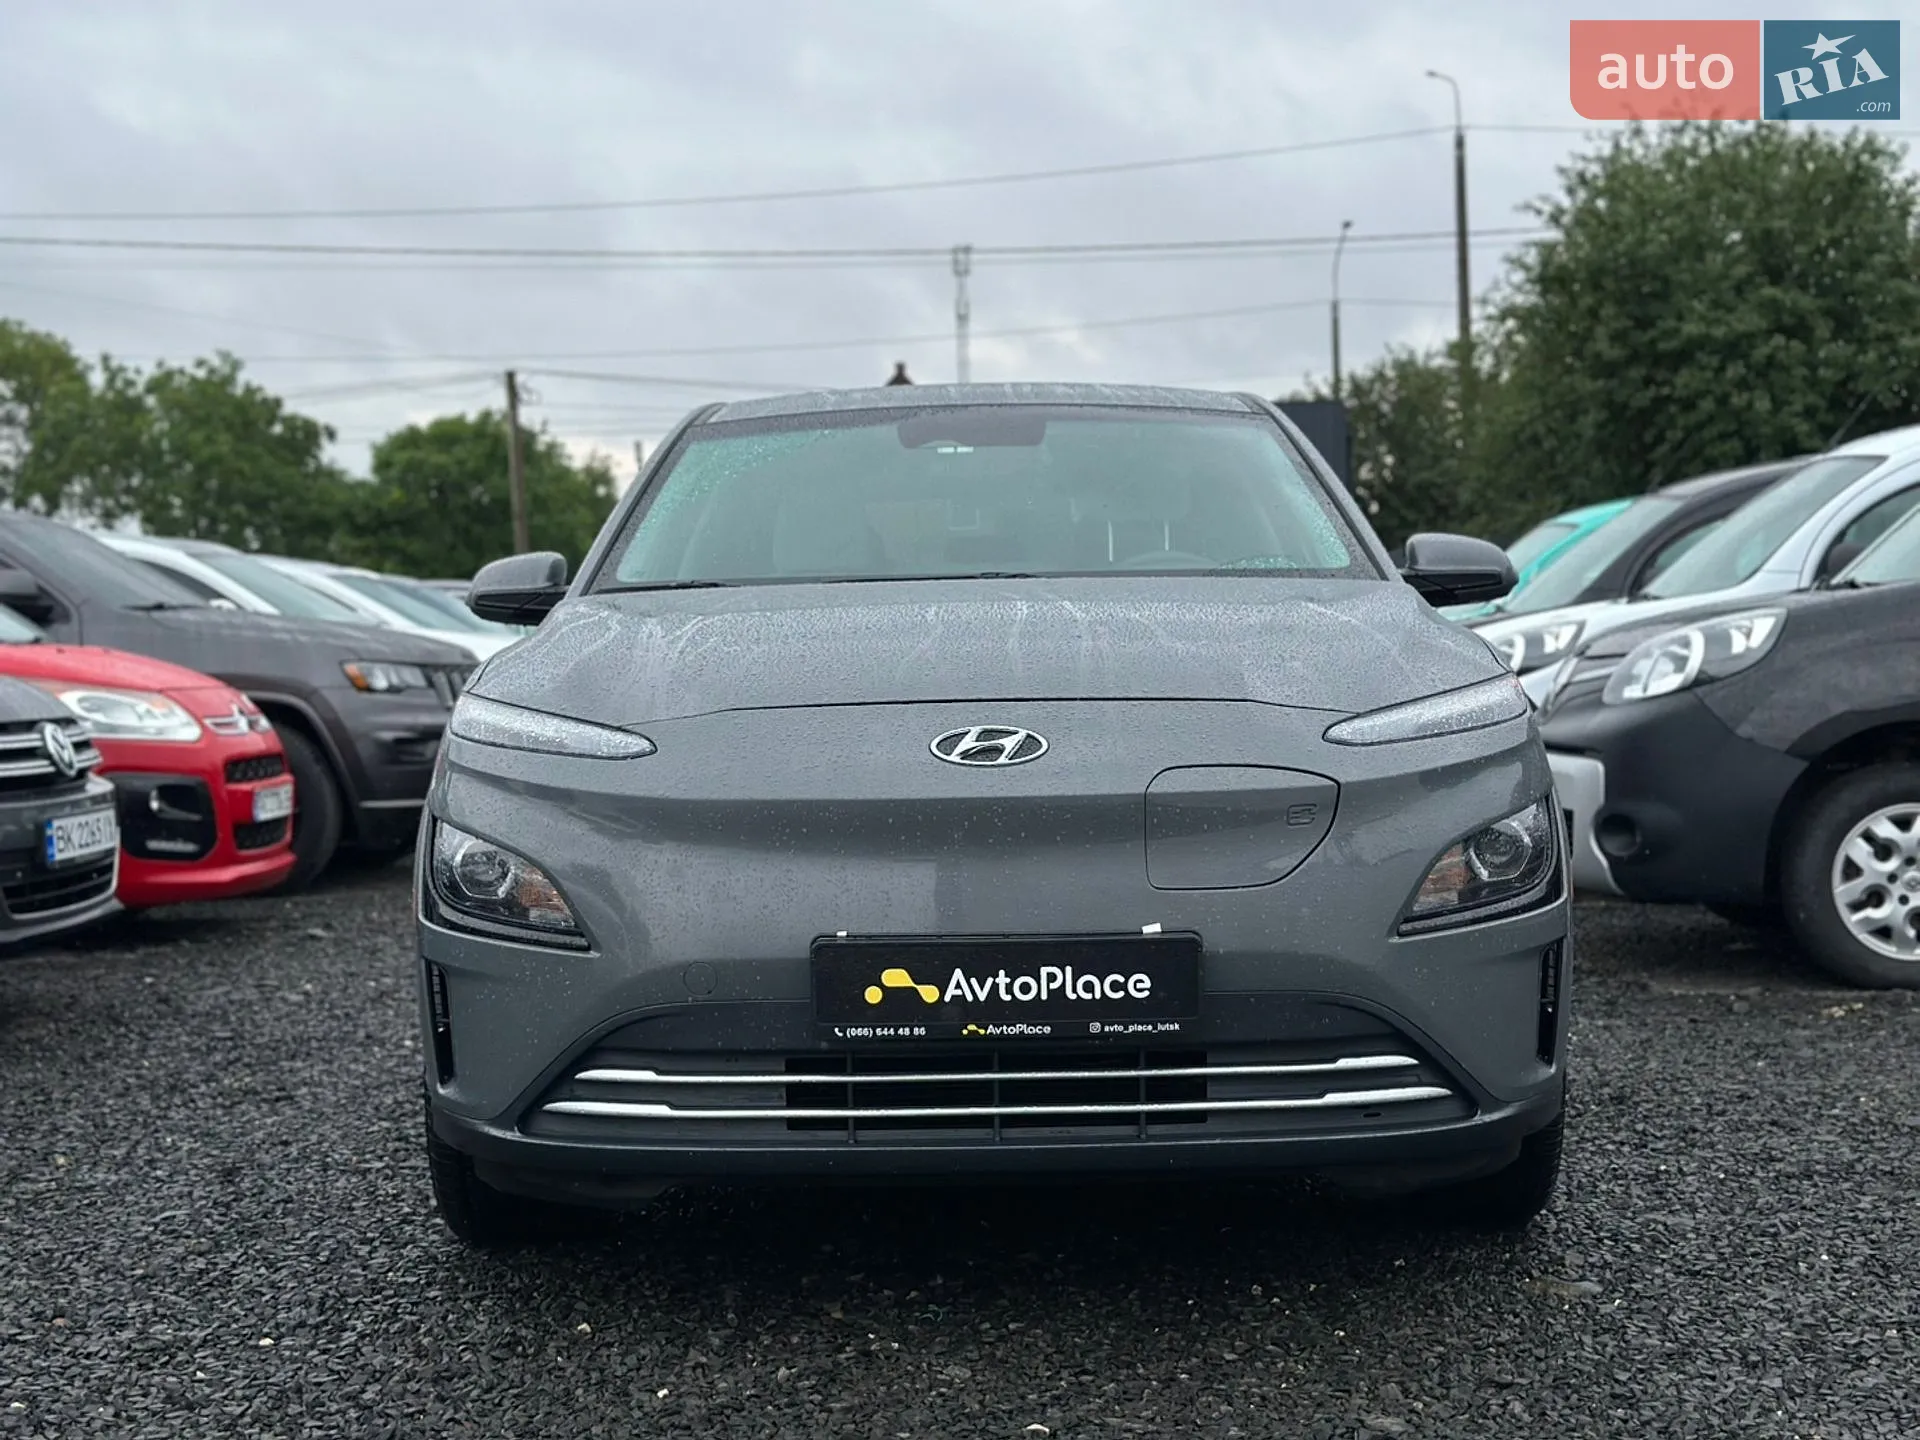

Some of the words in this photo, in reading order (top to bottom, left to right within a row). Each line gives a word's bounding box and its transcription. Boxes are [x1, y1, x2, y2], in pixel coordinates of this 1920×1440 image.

[944, 966, 1152, 1003] AvtoPlace
[846, 1027, 873, 1038] (066)
[876, 1027, 895, 1036] 644
[898, 1027, 910, 1036] 48
[986, 1024, 1052, 1035] AvtoPlace
[1104, 1022, 1180, 1033] avto_place_lutsk
